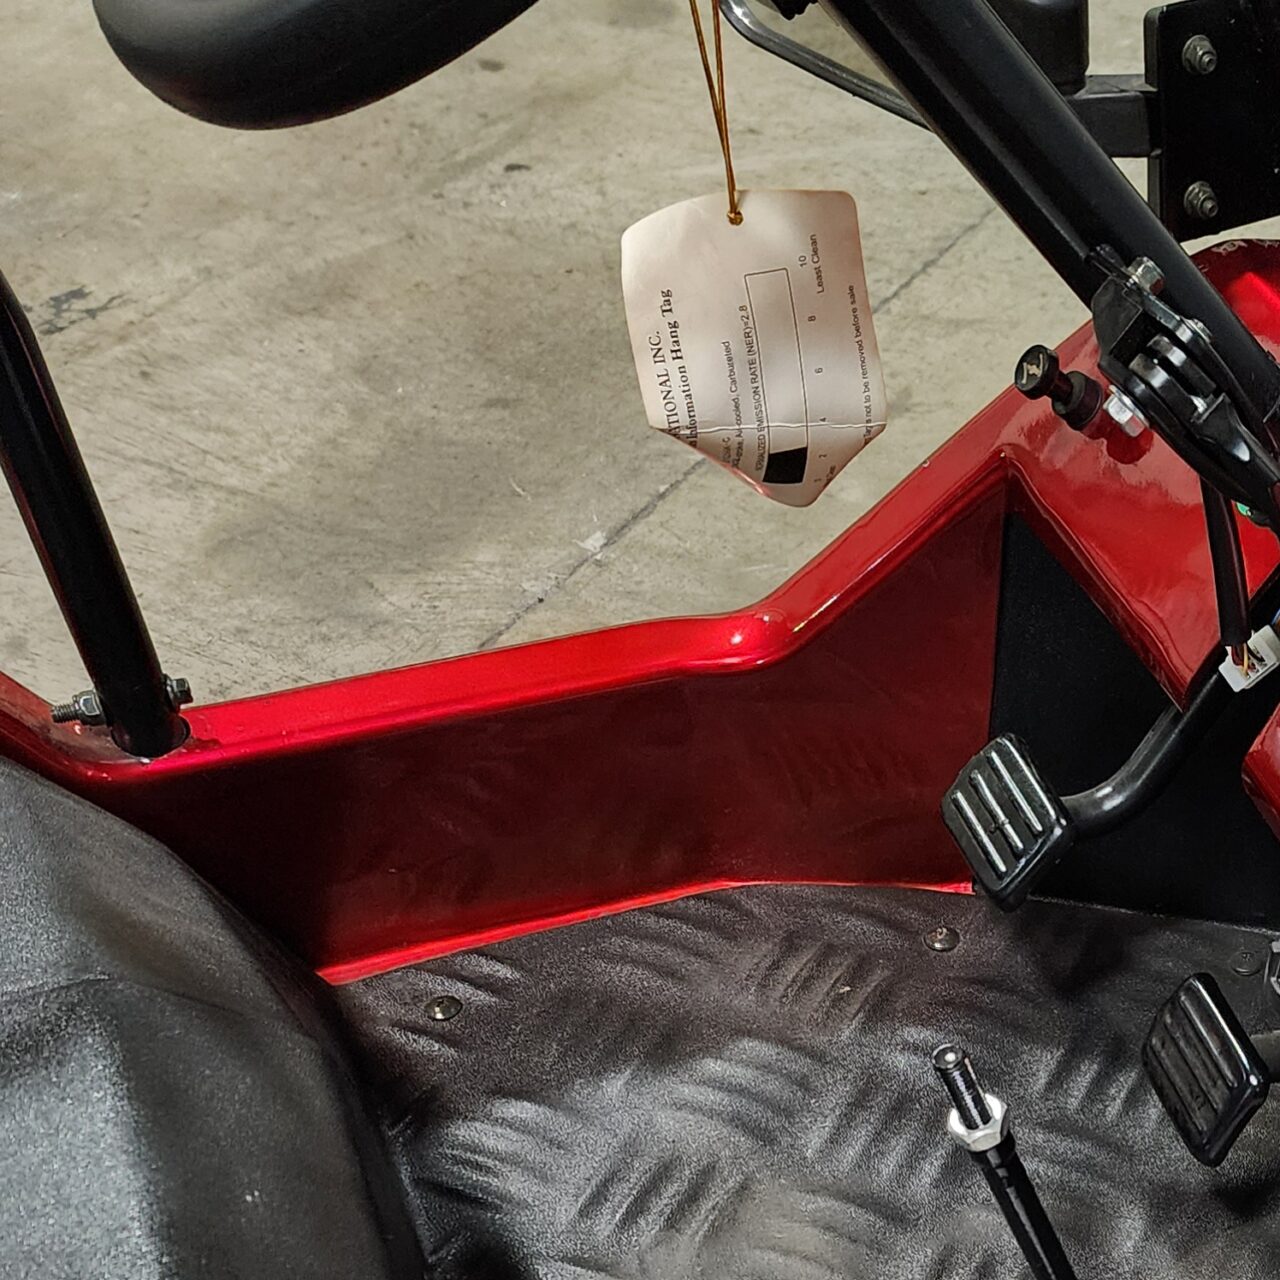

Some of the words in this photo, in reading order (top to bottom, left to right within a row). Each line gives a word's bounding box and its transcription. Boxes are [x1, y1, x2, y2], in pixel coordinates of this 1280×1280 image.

[798, 254, 807, 268] 10
[810, 233, 821, 264] Clean
[815, 265, 825, 295] Least
[660, 288, 674, 318] Tag
[647, 330, 668, 365] INC.
[668, 320, 684, 362] Hang
[749, 358, 761, 386] RATE
[752, 386, 766, 432] EMISSION
